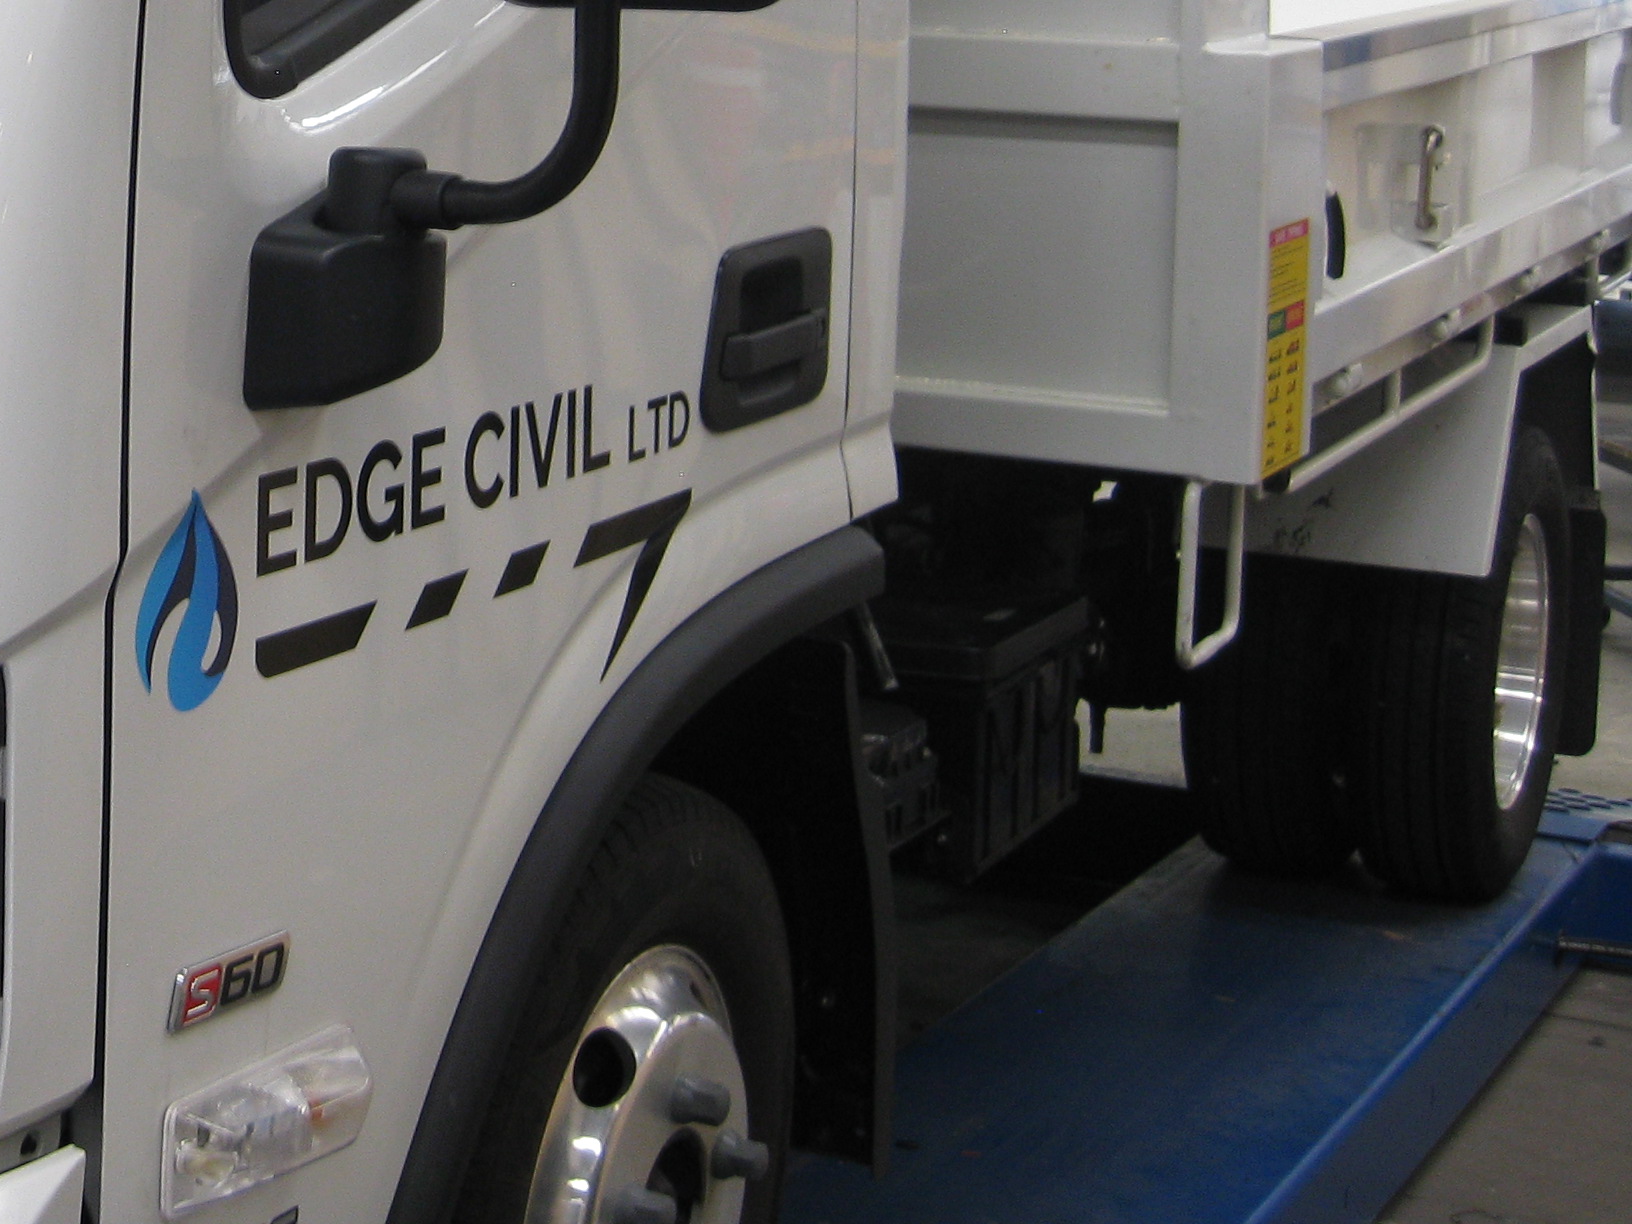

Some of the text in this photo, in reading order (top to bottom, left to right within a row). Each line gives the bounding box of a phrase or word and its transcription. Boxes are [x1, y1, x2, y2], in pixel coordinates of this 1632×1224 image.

[255, 384, 690, 578] EDGE CIVIL LTD
[185, 941, 286, 1018] S60
